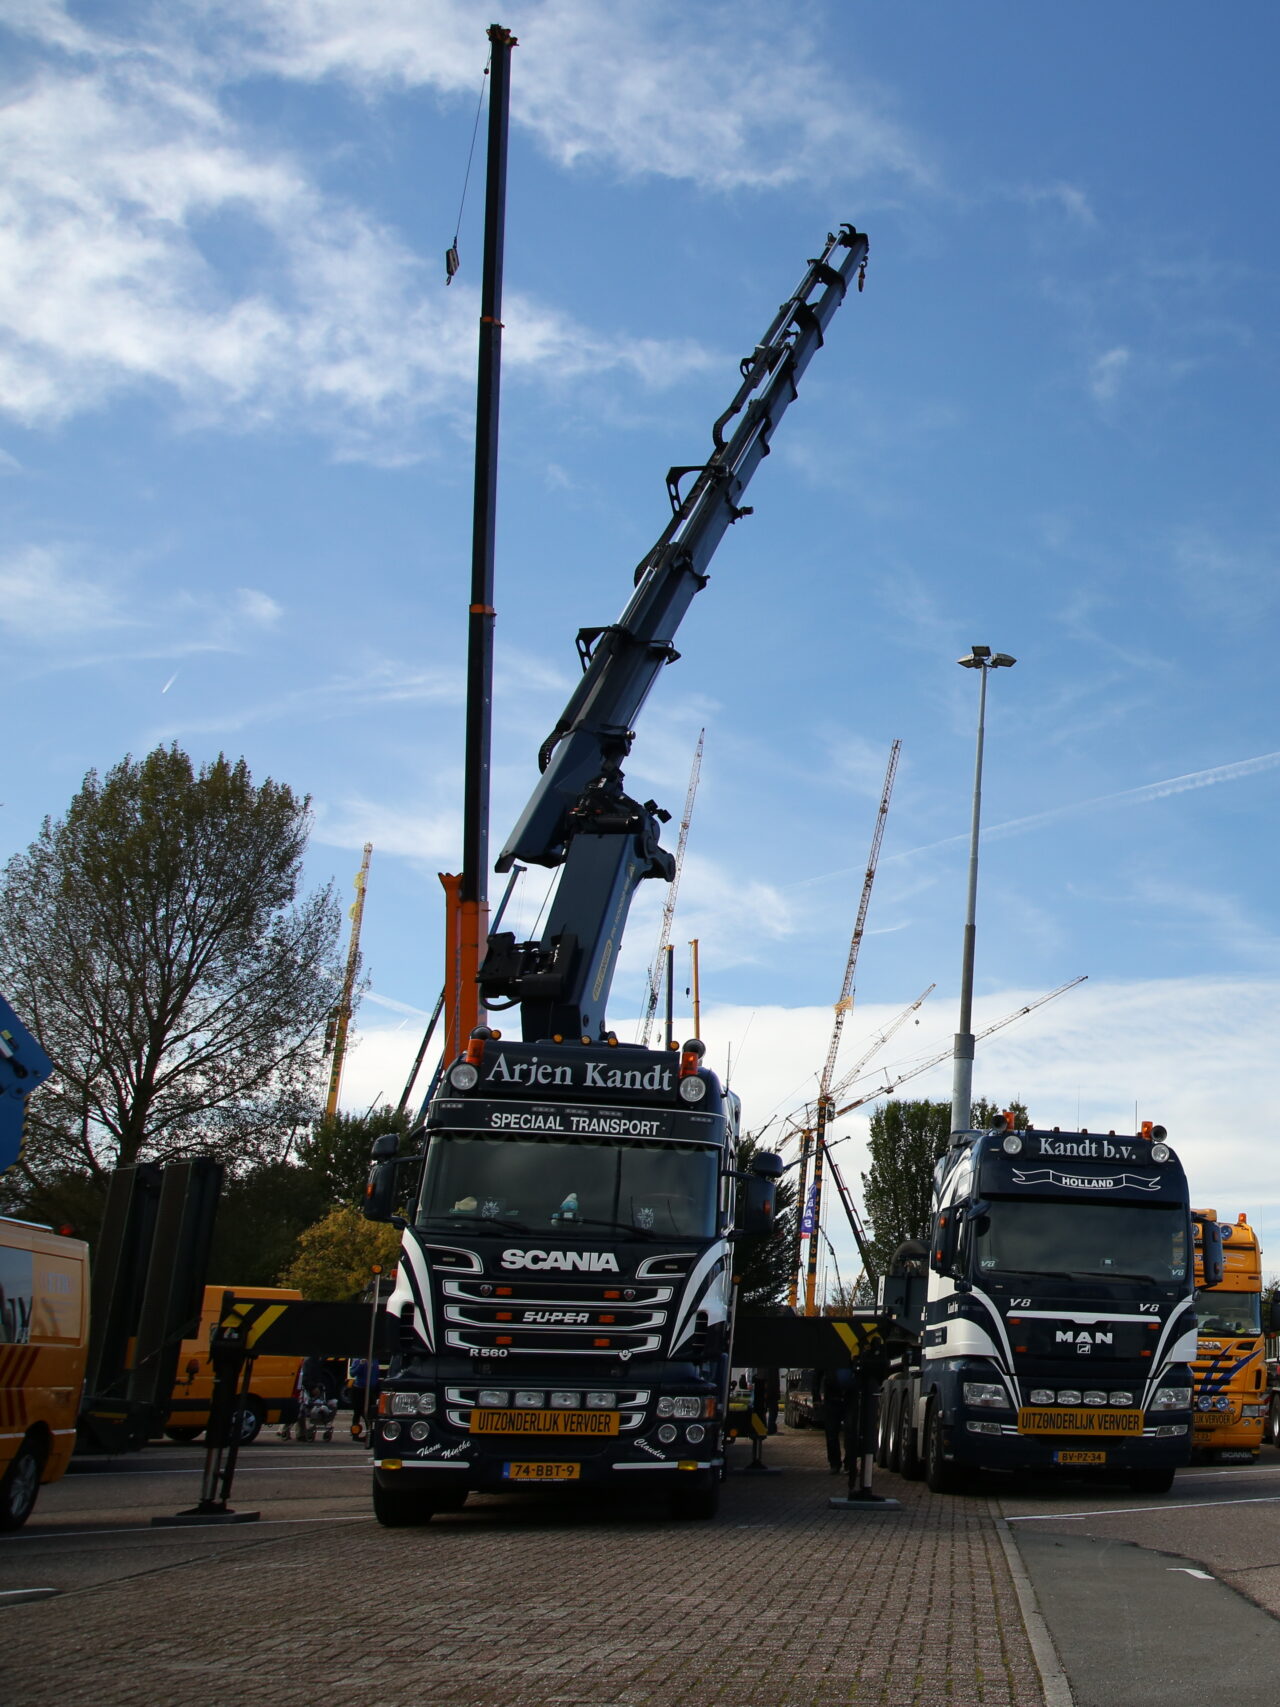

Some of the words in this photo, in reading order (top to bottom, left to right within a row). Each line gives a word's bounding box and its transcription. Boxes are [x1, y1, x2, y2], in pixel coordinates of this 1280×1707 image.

[486, 1053, 573, 1086] Arjen
[583, 1062, 673, 1091] Kandt
[490, 1113, 565, 1130] SPECIAAL
[570, 1117, 661, 1136] TRANSPORT
[1039, 1138, 1098, 1157] Kandt
[1103, 1140, 1136, 1160] b.v.
[1062, 1177, 1114, 1188] HOLLAND
[501, 1249, 620, 1272] SCANIA
[1171, 1268, 1184, 1276] V8
[1009, 1298, 1032, 1308] V8
[1138, 1303, 1160, 1312] V8
[522, 1311, 590, 1323] SUPER
[1055, 1330, 1113, 1344] MAN
[469, 1349, 479, 1357] R
[481, 1348, 508, 1358] 560
[478, 1411, 561, 1432] UITZONDERLIJK
[563, 1413, 612, 1433] VERVOER
[1022, 1412, 1095, 1430] UITZONDERLIJK
[1097, 1413, 1139, 1432] VERVOER
[416, 1443, 441, 1457] Thom
[633, 1438, 666, 1460] Claudia
[515, 1465, 575, 1476] 74-BBT-9
